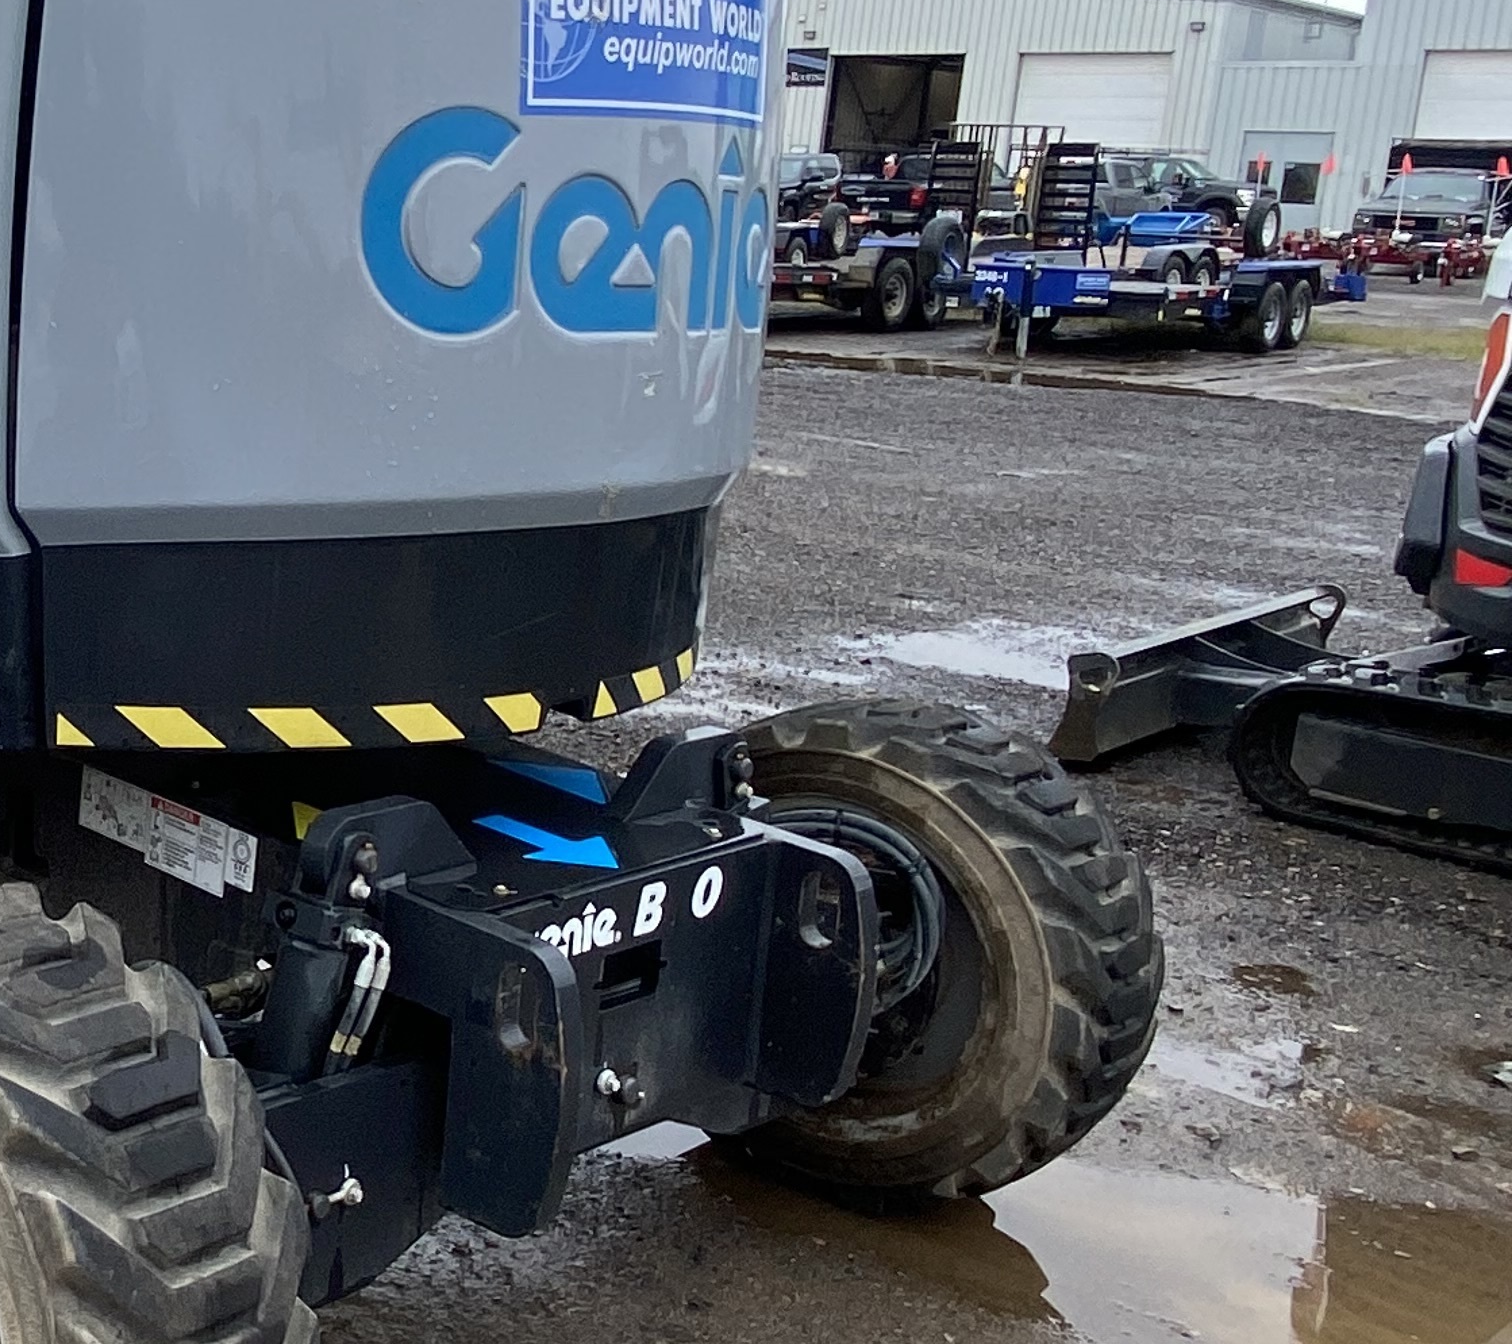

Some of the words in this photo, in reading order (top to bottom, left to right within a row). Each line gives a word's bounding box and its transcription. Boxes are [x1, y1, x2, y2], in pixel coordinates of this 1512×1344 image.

[603, 32, 759, 78] equipworld.com
[360, 106, 769, 342] Genie
[633, 881, 667, 937] B
